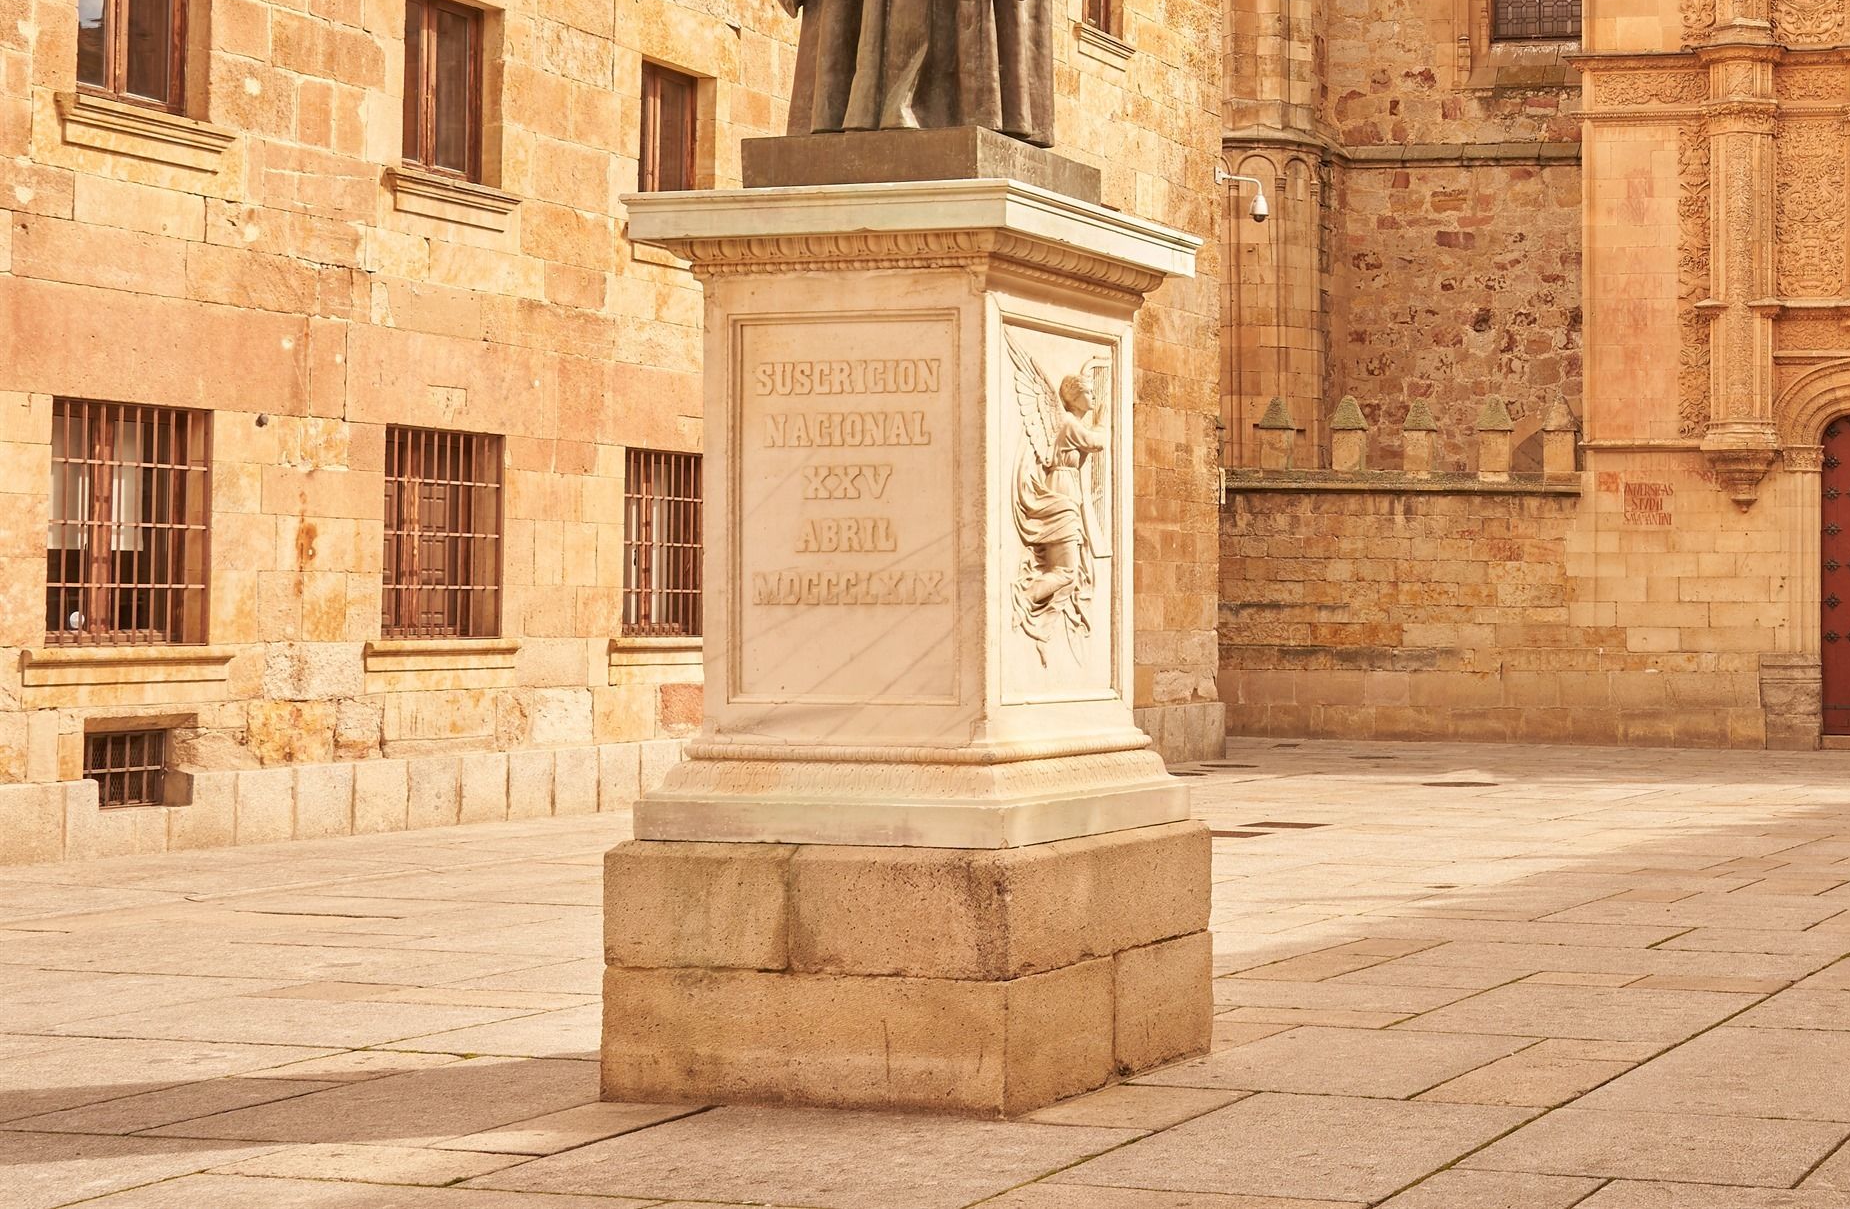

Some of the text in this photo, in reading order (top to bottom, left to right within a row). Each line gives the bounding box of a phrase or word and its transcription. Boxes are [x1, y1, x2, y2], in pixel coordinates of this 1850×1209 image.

[755, 358, 941, 396] SUSCRICION
[763, 411, 932, 448] NACIONAL
[803, 464, 893, 500] XXV
[794, 517, 898, 553] ABRIL
